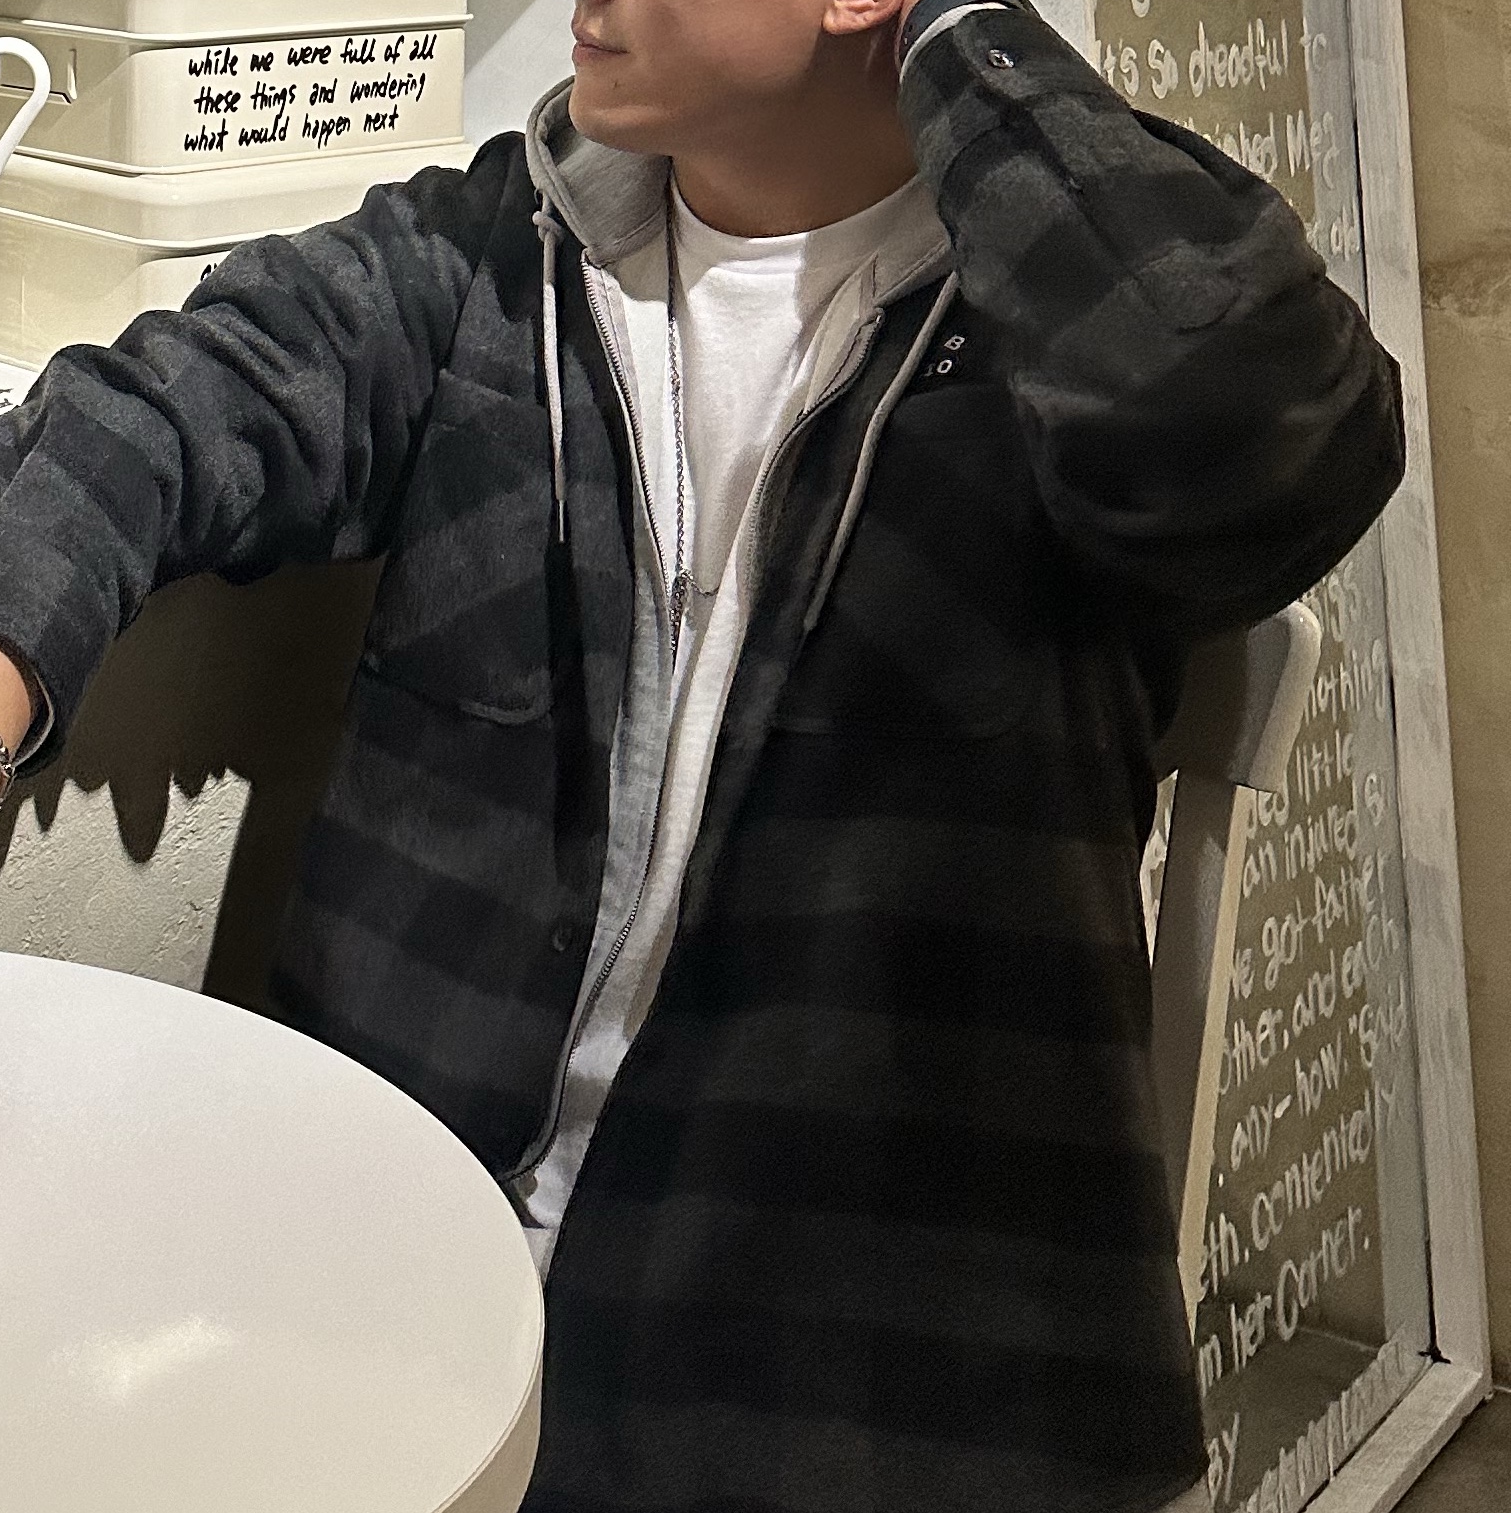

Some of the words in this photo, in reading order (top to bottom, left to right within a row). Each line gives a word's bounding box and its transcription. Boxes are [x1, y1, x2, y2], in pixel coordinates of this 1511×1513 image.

[287, 45, 331, 66] were
[340, 38, 376, 64] full
[384, 35, 404, 64] of
[409, 34, 437, 61] all
[194, 86, 241, 115] these
[250, 81, 296, 110] things
[310, 78, 337, 106] and
[238, 115, 290, 146] would
[302, 113, 350, 149] happen
[364, 104, 399, 133] next
